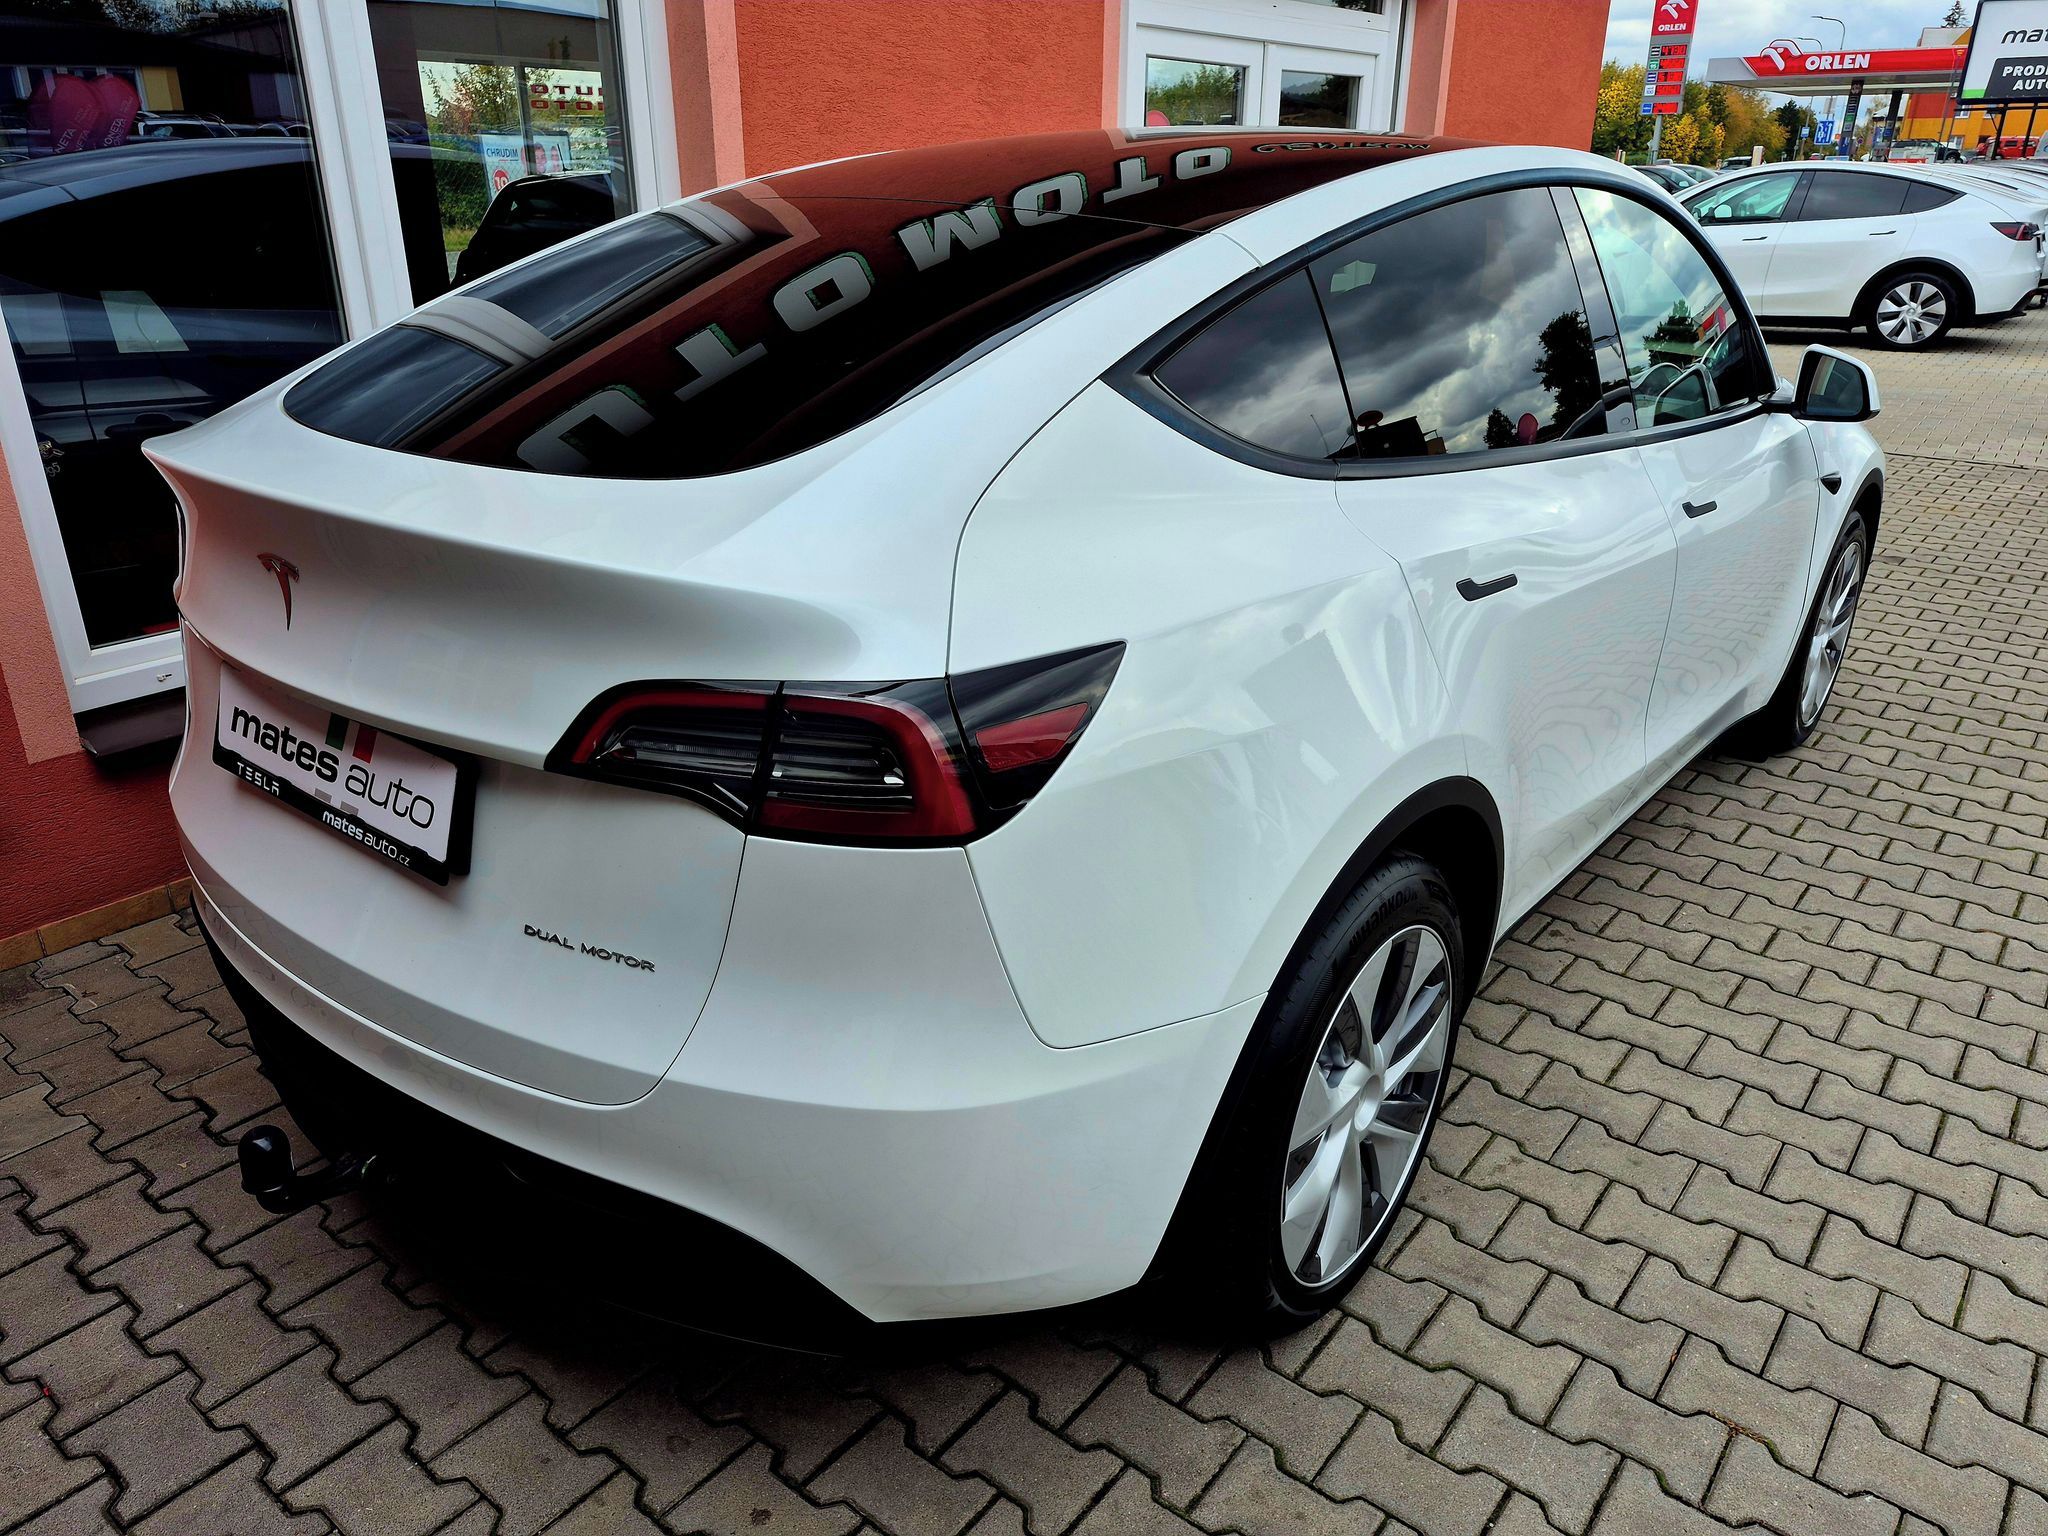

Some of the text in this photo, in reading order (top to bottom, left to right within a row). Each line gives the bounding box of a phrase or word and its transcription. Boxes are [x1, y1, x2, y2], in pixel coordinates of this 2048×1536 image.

[1657, 23, 1687, 32] ORLEN
[1805, 53, 1871, 71] ORLEN
[486, 147, 519, 158] CHRUDIM
[230, 705, 436, 830] mates auto
[236, 761, 280, 797] TESLA
[523, 923, 656, 973] DUAL MOTOR
